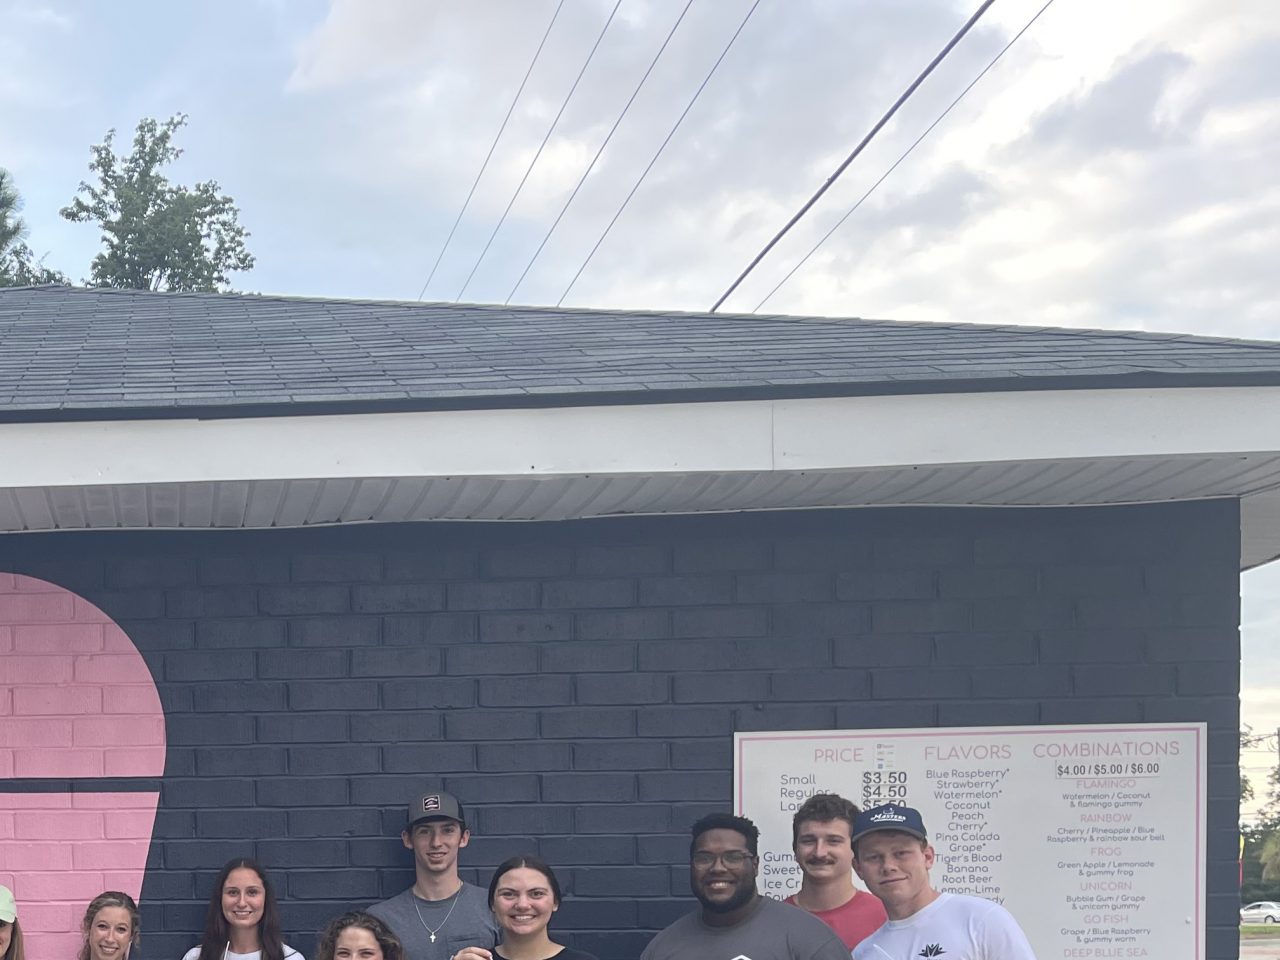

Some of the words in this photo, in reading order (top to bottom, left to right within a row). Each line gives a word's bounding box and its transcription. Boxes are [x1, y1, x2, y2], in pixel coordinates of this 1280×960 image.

[924, 744, 1012, 760] FLAVORS
[1033, 741, 1180, 758] COMBINATIONS
[814, 748, 864, 762] PRICE
[926, 769, 949, 779] Blue
[1057, 765, 1085, 776] $4.00
[1094, 764, 1123, 775] $5.00
[1131, 763, 1159, 774] $6.00
[780, 774, 816, 785] Small
[863, 771, 907, 784] $3.50
[1076, 780, 1136, 789] FLAMINGO
[780, 787, 830, 800] Regular
[863, 785, 907, 798] $4.50
[1062, 793, 1110, 801] Watermelon
[1117, 792, 1151, 800] Coconut
[780, 802, 803, 812] Lar
[945, 801, 991, 810] Coconut
[1078, 800, 1112, 809] flamingo
[1114, 801, 1143, 809] gummy
[952, 811, 984, 820] Peach
[1080, 814, 1133, 823] RAINBOW
[1057, 827, 1085, 836] Cherry
[1092, 827, 1131, 835] Pineapple
[1138, 826, 1155, 834] Blue
[961, 832, 1000, 841] Colada
[1046, 835, 1087, 844] Raspberry
[1096, 834, 1129, 842] rainbow
[1091, 847, 1122, 856] FROG
[763, 852, 796, 862] Gum
[934, 853, 969, 864] Tiger's
[971, 853, 1002, 862] Blood
[947, 864, 989, 873] Banana
[1057, 861, 1081, 869] Green
[1083, 861, 1106, 869] Apple
[763, 865, 801, 876] Sweet
[1078, 869, 1084, 877] &
[1086, 869, 1115, 877] gummy
[1117, 869, 1134, 877] frog
[942, 875, 966, 883] Root
[968, 874, 993, 883] Beer
[763, 879, 783, 889] Ice
[1080, 882, 1132, 891] UNICORN
[1066, 895, 1094, 903] Bubble
[1121, 894, 1146, 902] Grape
[1111, 903, 1140, 911] gummy
[1083, 915, 1102, 924] GO
[1104, 914, 1129, 924] FISH
[1060, 928, 1085, 936] Grape
[1092, 927, 1109, 935] Blue
[1111, 927, 1151, 935] Raspberry
[1084, 936, 1112, 944] gummy
[1064, 948, 1093, 958] DEEP
[1095, 948, 1123, 957] BLUE
[1126, 947, 1148, 957] SEA
